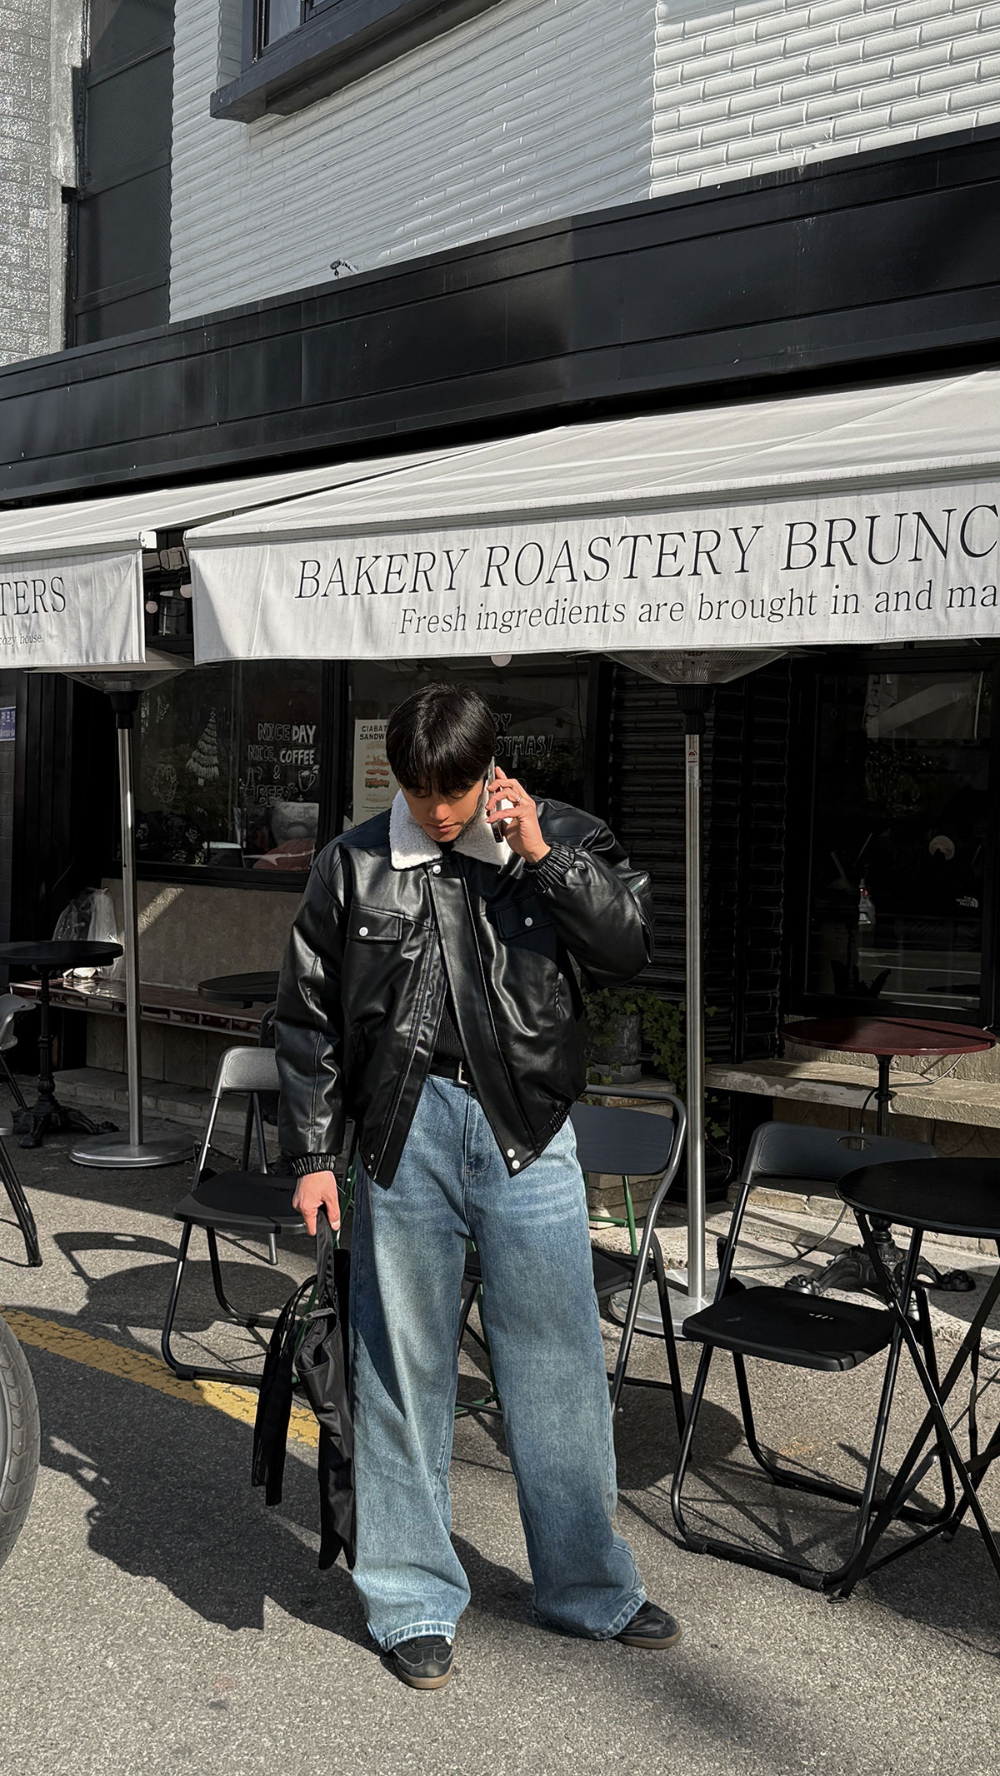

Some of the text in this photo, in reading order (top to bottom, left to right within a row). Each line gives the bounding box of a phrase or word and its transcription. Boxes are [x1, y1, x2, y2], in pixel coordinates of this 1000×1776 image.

[295, 504, 999, 600] BAKERY ROASTERY BRUNC
[0, 576, 67, 616] TERS
[399, 580, 999, 635] Fresh ingredients are brought in and ma
[257, 722, 317, 744] NICE DAY
[272, 765, 281, 779] &
[279, 748, 316, 766] COFFEE
